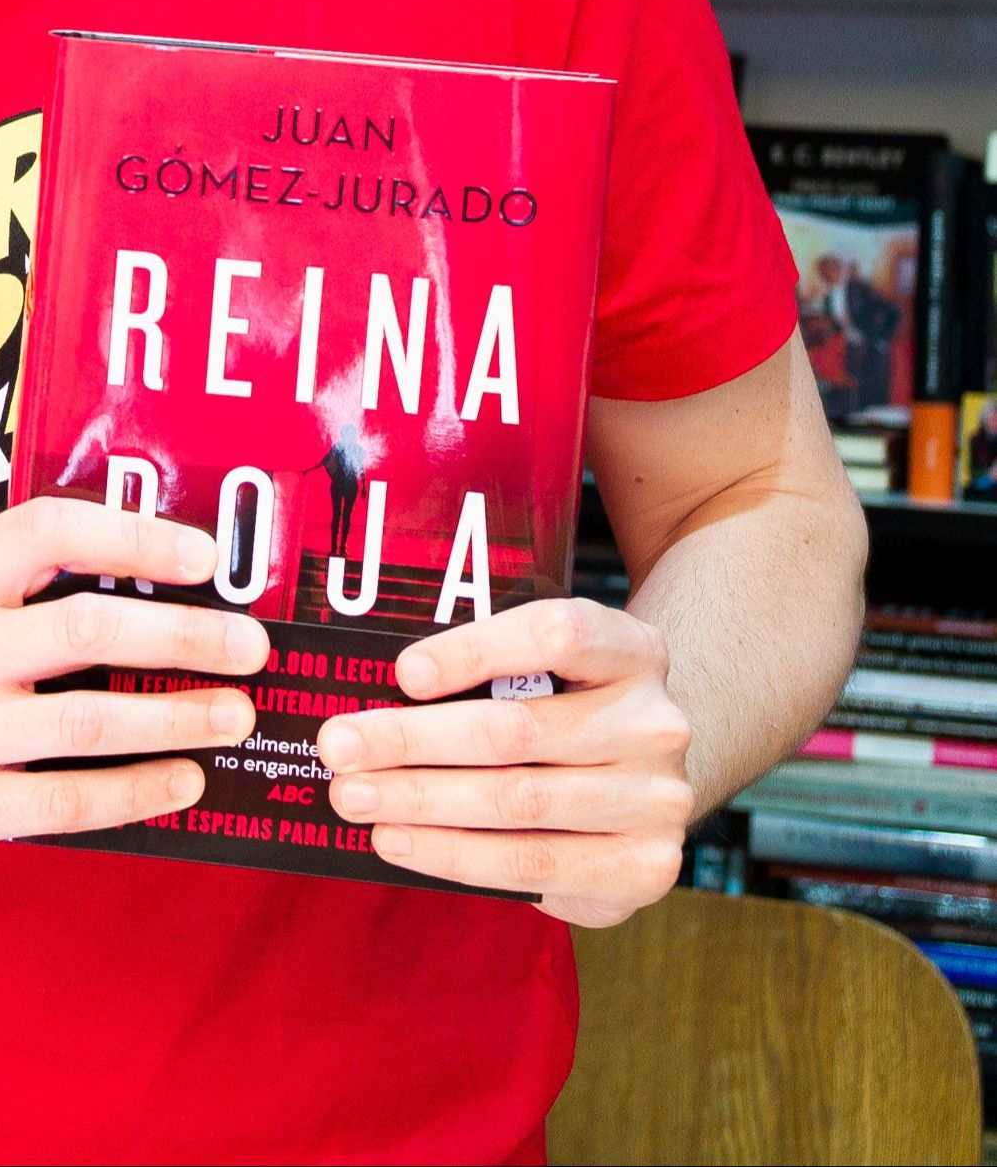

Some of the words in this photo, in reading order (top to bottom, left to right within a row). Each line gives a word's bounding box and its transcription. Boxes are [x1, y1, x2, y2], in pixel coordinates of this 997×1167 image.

[262, 103, 396, 153] JUAN
[116, 147, 538, 227] GÓMEZ-JURADO
[106, 248, 521, 426] REINA
[255, 686, 361, 719] LITERARIO
[214, 755, 238, 770] no
[266, 783, 316, 806] ABC
[187, 808, 274, 842] ESPERAS
[279, 820, 329, 849] PARA
